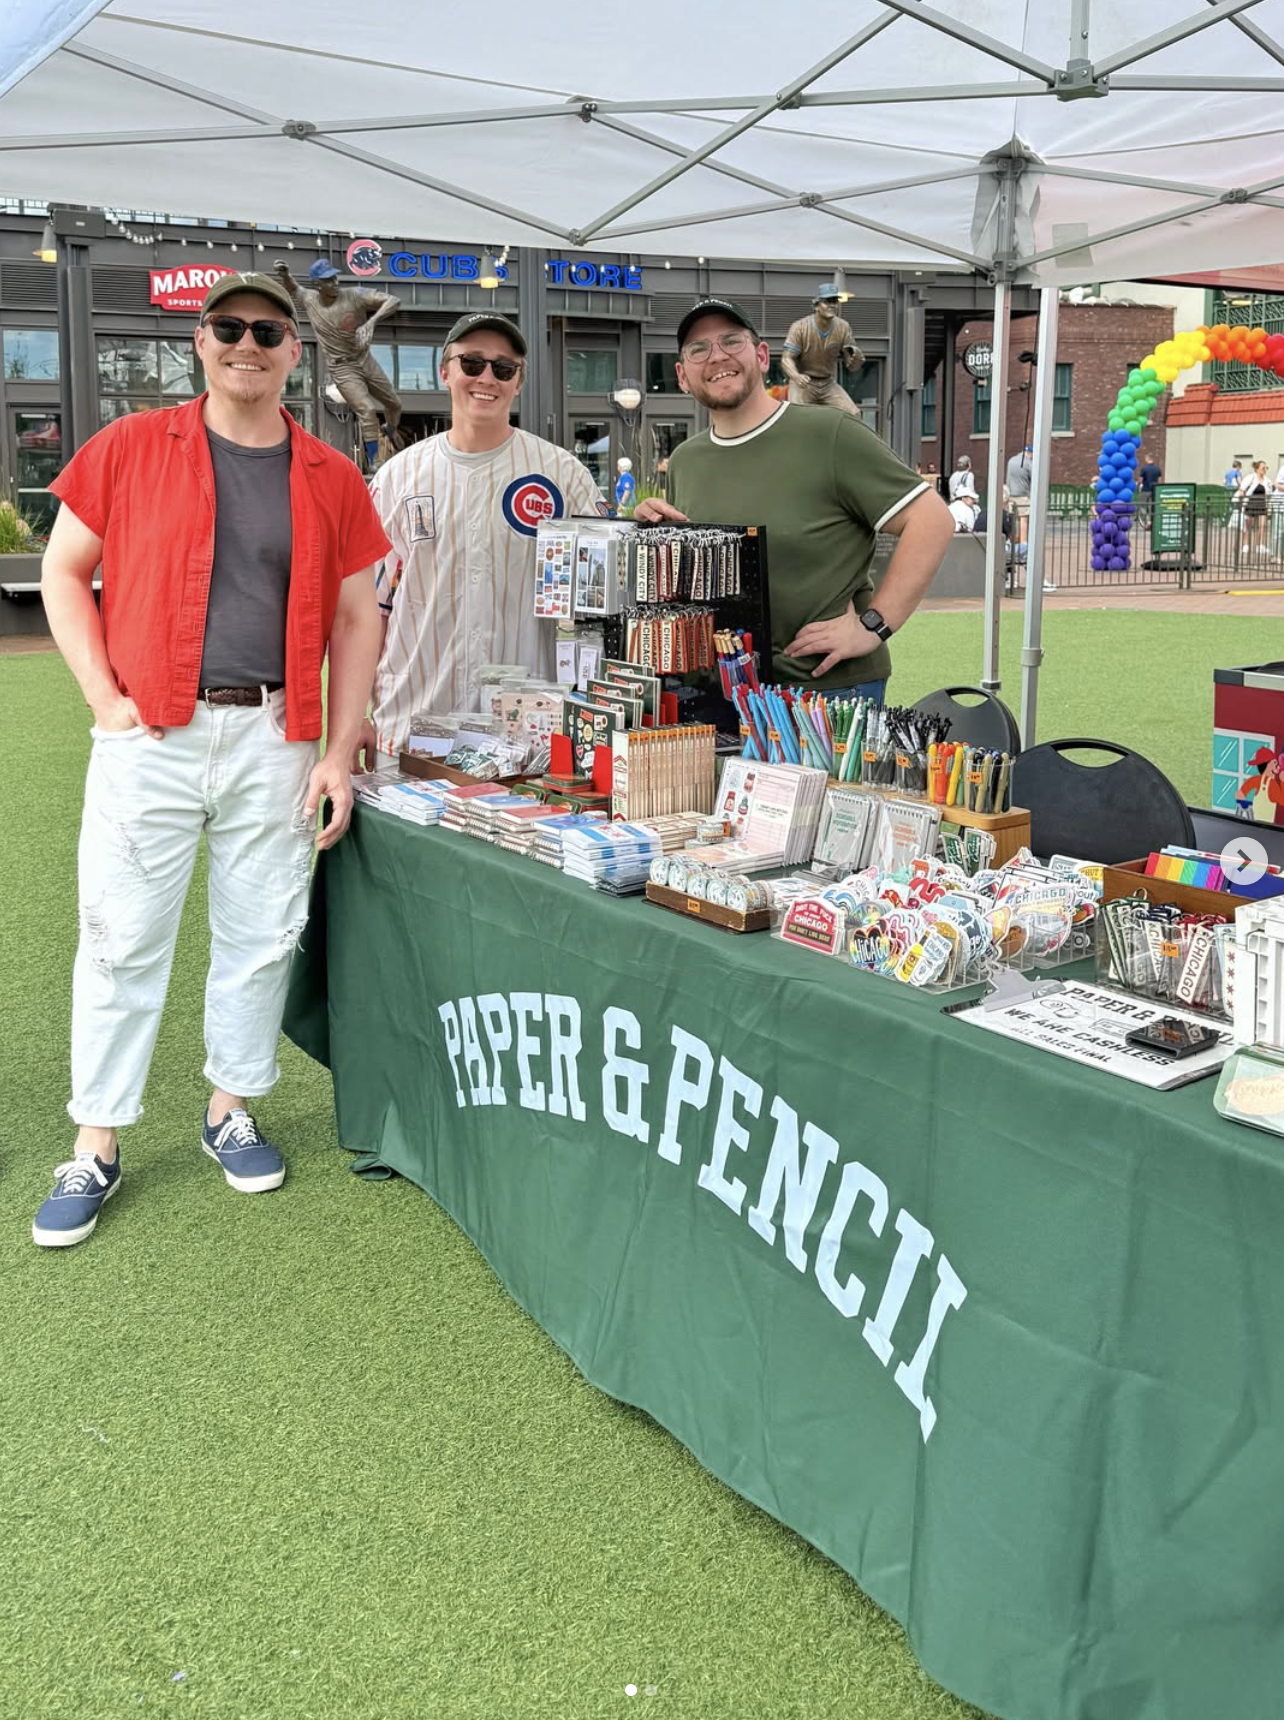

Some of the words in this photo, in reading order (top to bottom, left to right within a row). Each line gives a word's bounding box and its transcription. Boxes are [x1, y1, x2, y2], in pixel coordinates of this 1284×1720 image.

[153, 268, 227, 296] MARQ
[545, 259, 643, 290] TORE
[513, 482, 554, 527] CUBS
[638, 553, 646, 580] WINDY
[638, 581, 646, 600] CITY
[663, 627, 671, 670] CHICAGO
[1015, 888, 1066, 904] CHICAGO
[794, 913, 828, 931] CHICAGO
[1181, 936, 1208, 998] CHICAGO
[1060, 987, 1137, 1016] PAPER
[1004, 1008, 1030, 1021] WE
[1033, 1018, 1075, 1036] ARE
[1072, 1032, 1176, 1067] CASHLESS
[1073, 1047, 1114, 1063] FINAL
[438, 992, 587, 1123] PAPER
[602, 1005, 650, 1143] &
[658, 1024, 968, 1444] PENCIL
